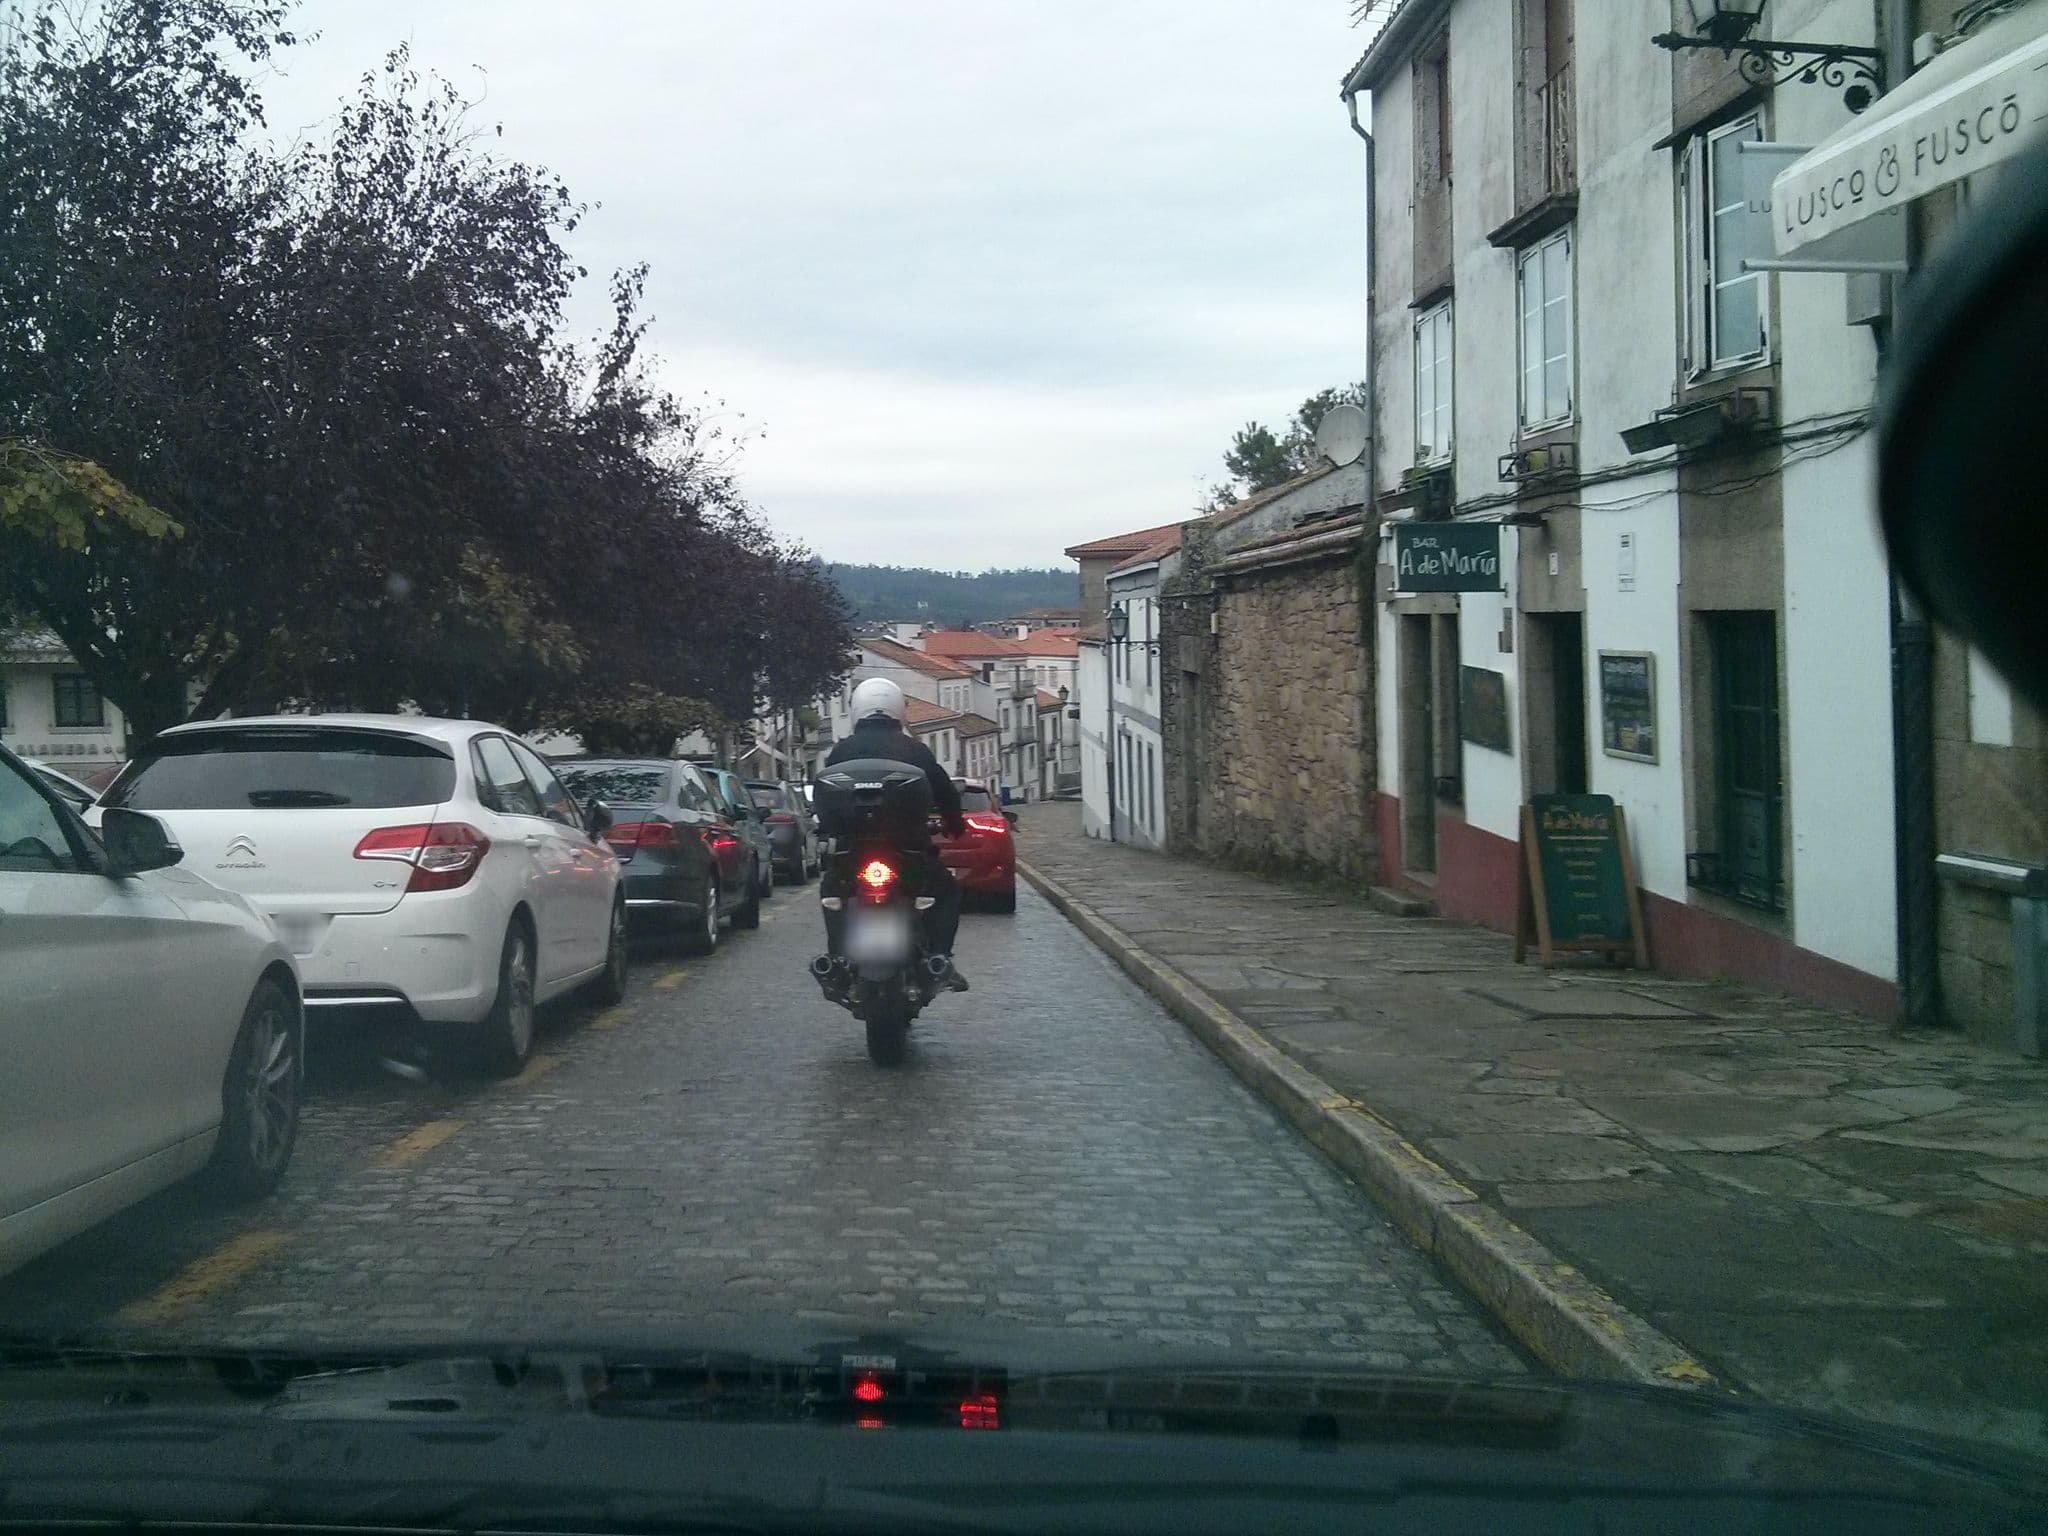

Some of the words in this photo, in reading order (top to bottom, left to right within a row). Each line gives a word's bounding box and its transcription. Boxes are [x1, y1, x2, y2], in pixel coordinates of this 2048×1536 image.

[1874, 143, 1900, 197] &
[1411, 537, 1440, 548] BAR
[1400, 549, 1414, 575] A
[1417, 554, 1439, 575] de
[1440, 547, 1496, 576] María
